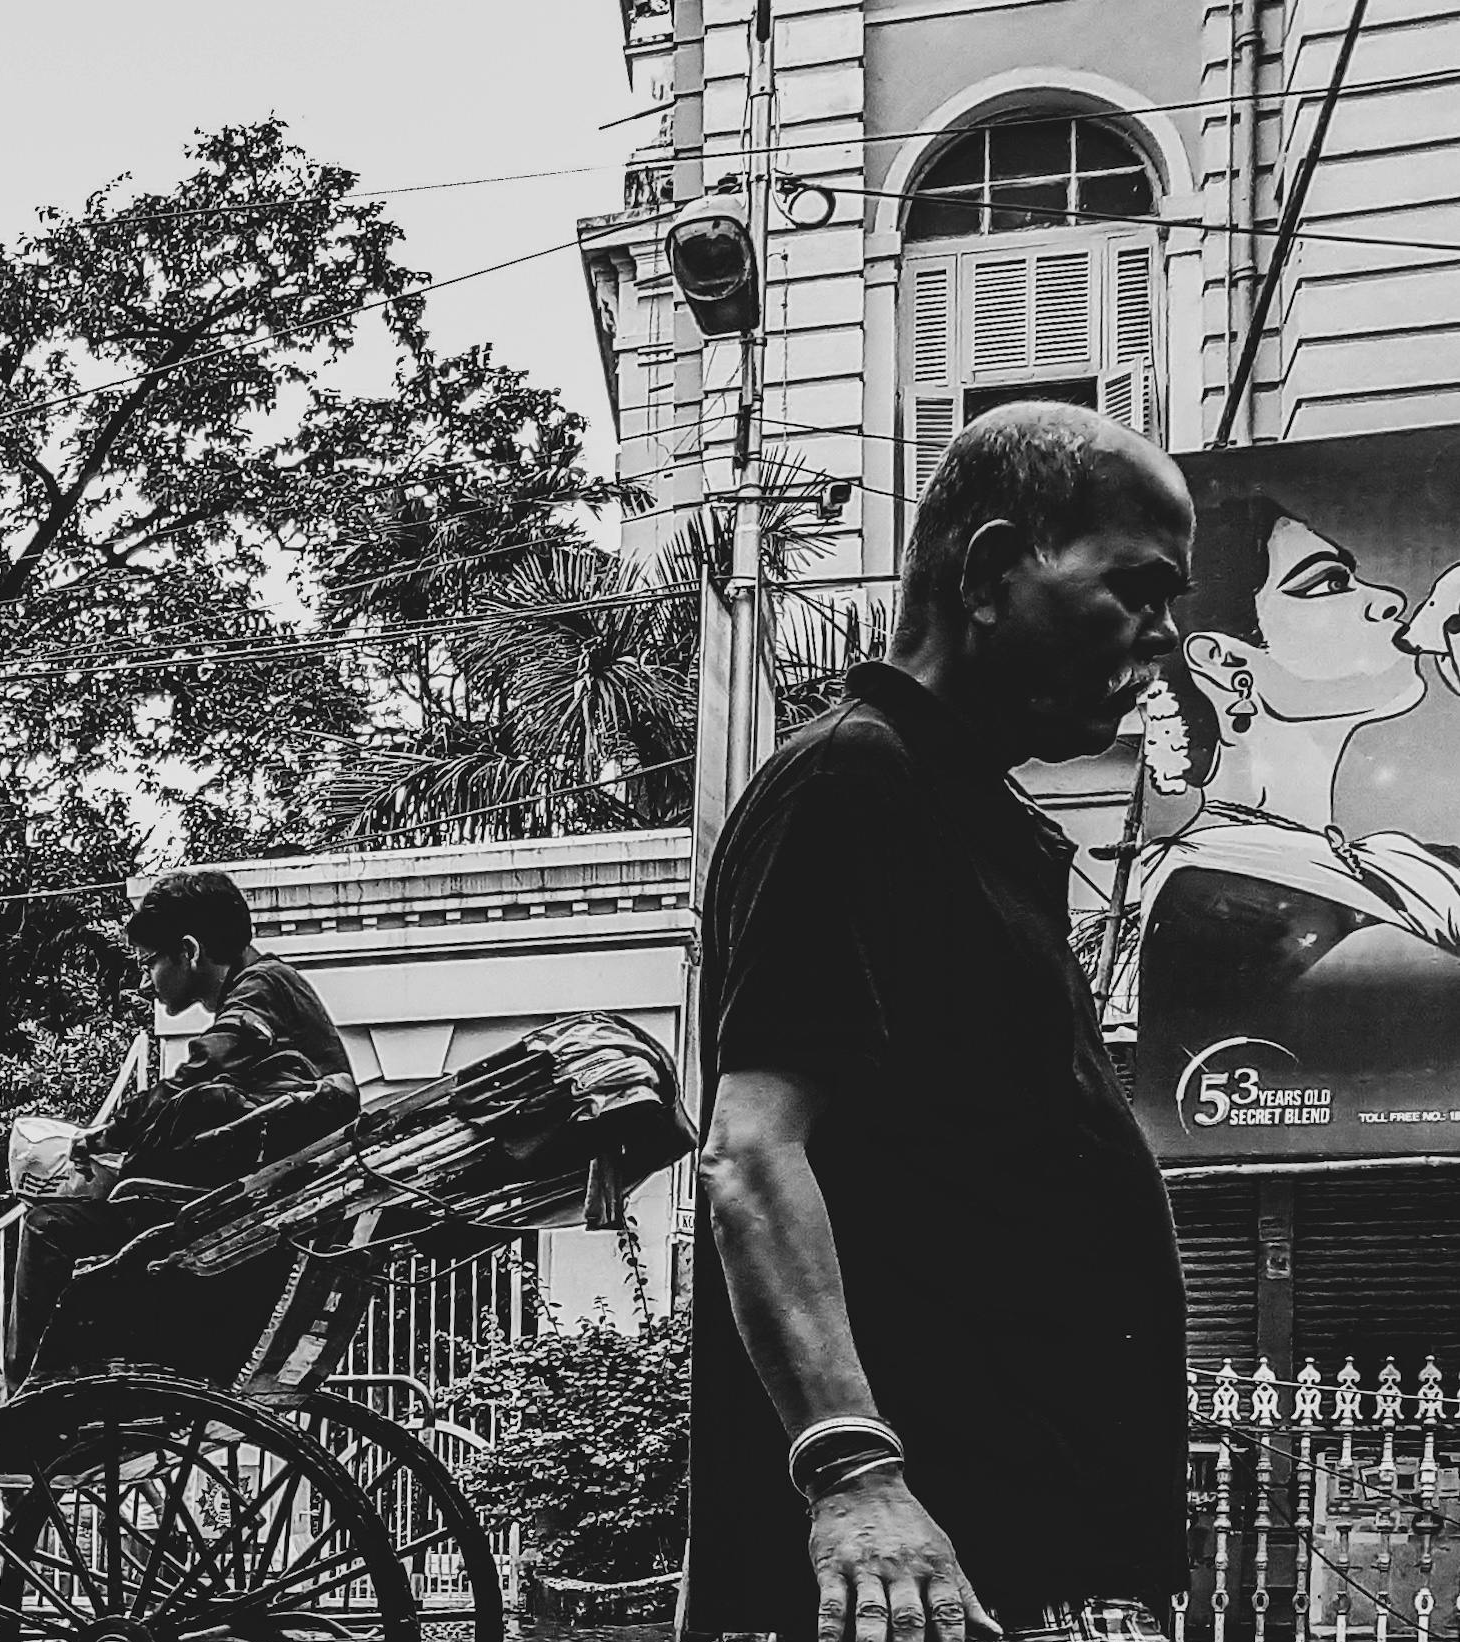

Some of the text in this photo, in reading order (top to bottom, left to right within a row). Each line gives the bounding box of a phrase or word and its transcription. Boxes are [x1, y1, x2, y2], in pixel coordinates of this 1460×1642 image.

[1259, 1088, 1331, 1107] YEARS OLD
[1229, 1108, 1330, 1126] SECRET BLEND
[1389, 1111, 1421, 1123] FREE
